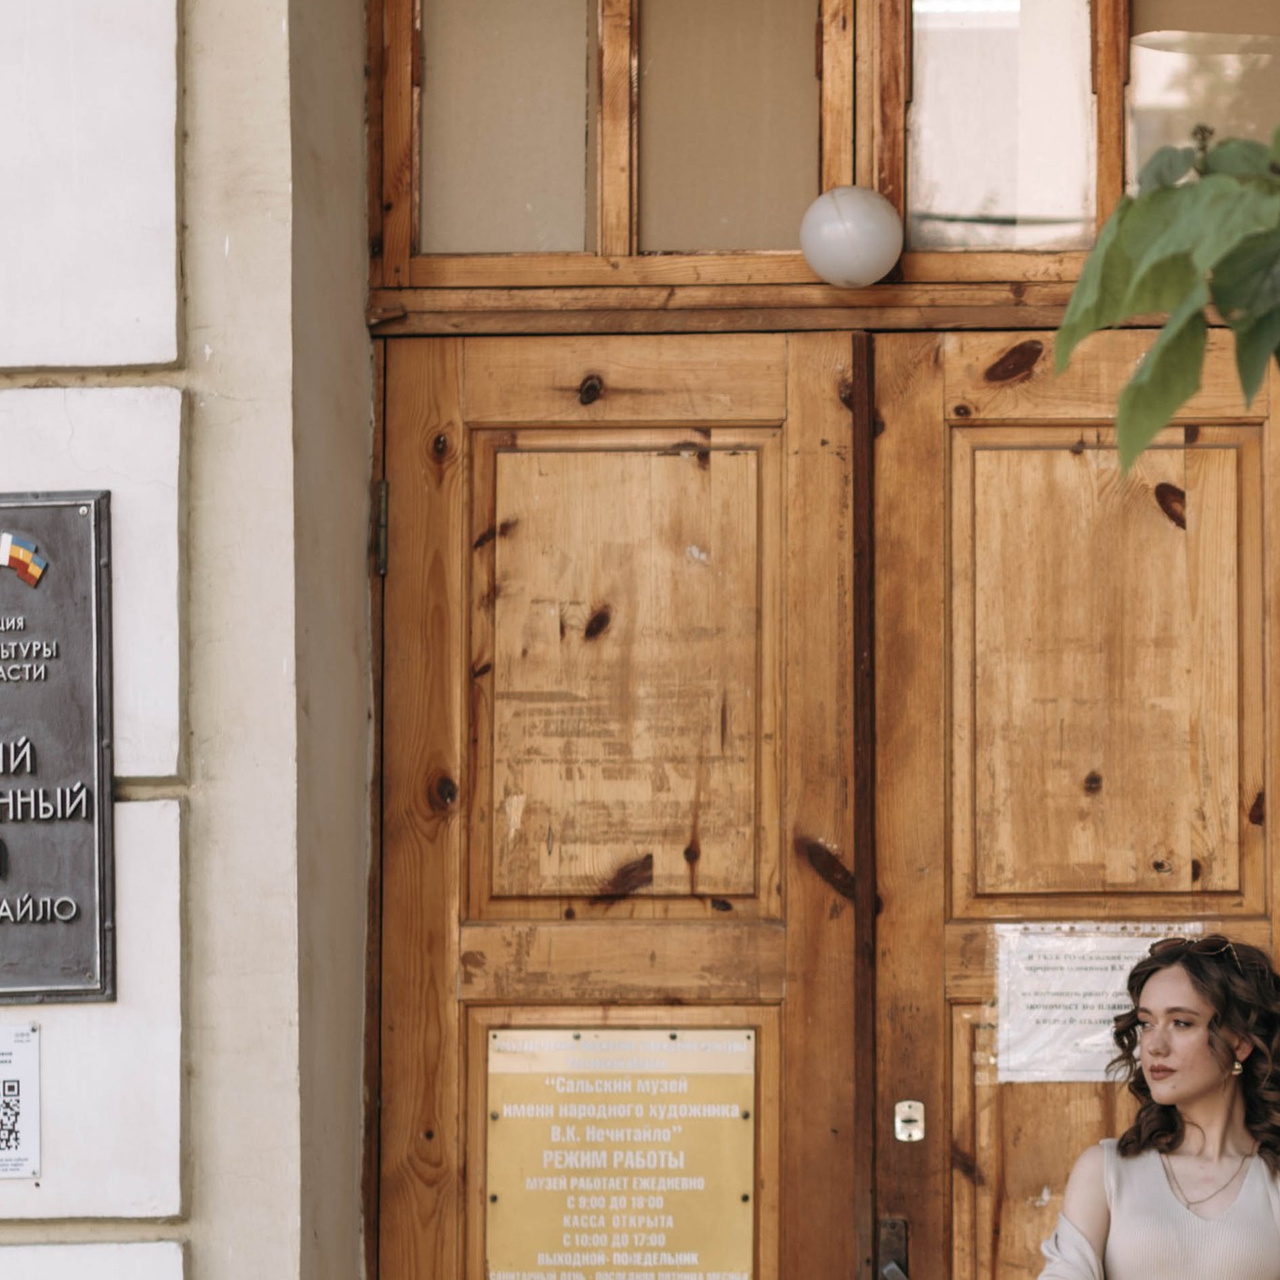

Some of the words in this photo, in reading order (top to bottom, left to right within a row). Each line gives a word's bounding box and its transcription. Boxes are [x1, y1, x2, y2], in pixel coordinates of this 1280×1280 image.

[0, 892, 77, 922] АЙЛО
[503, 1103, 554, 1118] имени
[559, 1103, 643, 1120] народного
[648, 1103, 739, 1120] художника
[543, 1150, 607, 1169] РЕЖИМ
[613, 1150, 685, 1169] РАБОТЫ
[526, 1175, 567, 1191] МУЗЕЙ
[570, 1176, 628, 1191] РАБОТАЕТ
[632, 1176, 705, 1192] ЕЖЕДНЕВНО
[609, 1196, 626, 1211] ДО
[563, 1215, 605, 1228] КАССА
[612, 1215, 674, 1228] ОТКРЫТА
[574, 1233, 607, 1247] 10:00
[611, 1233, 629, 1249] ДО
[633, 1233, 666, 1247] 17:00
